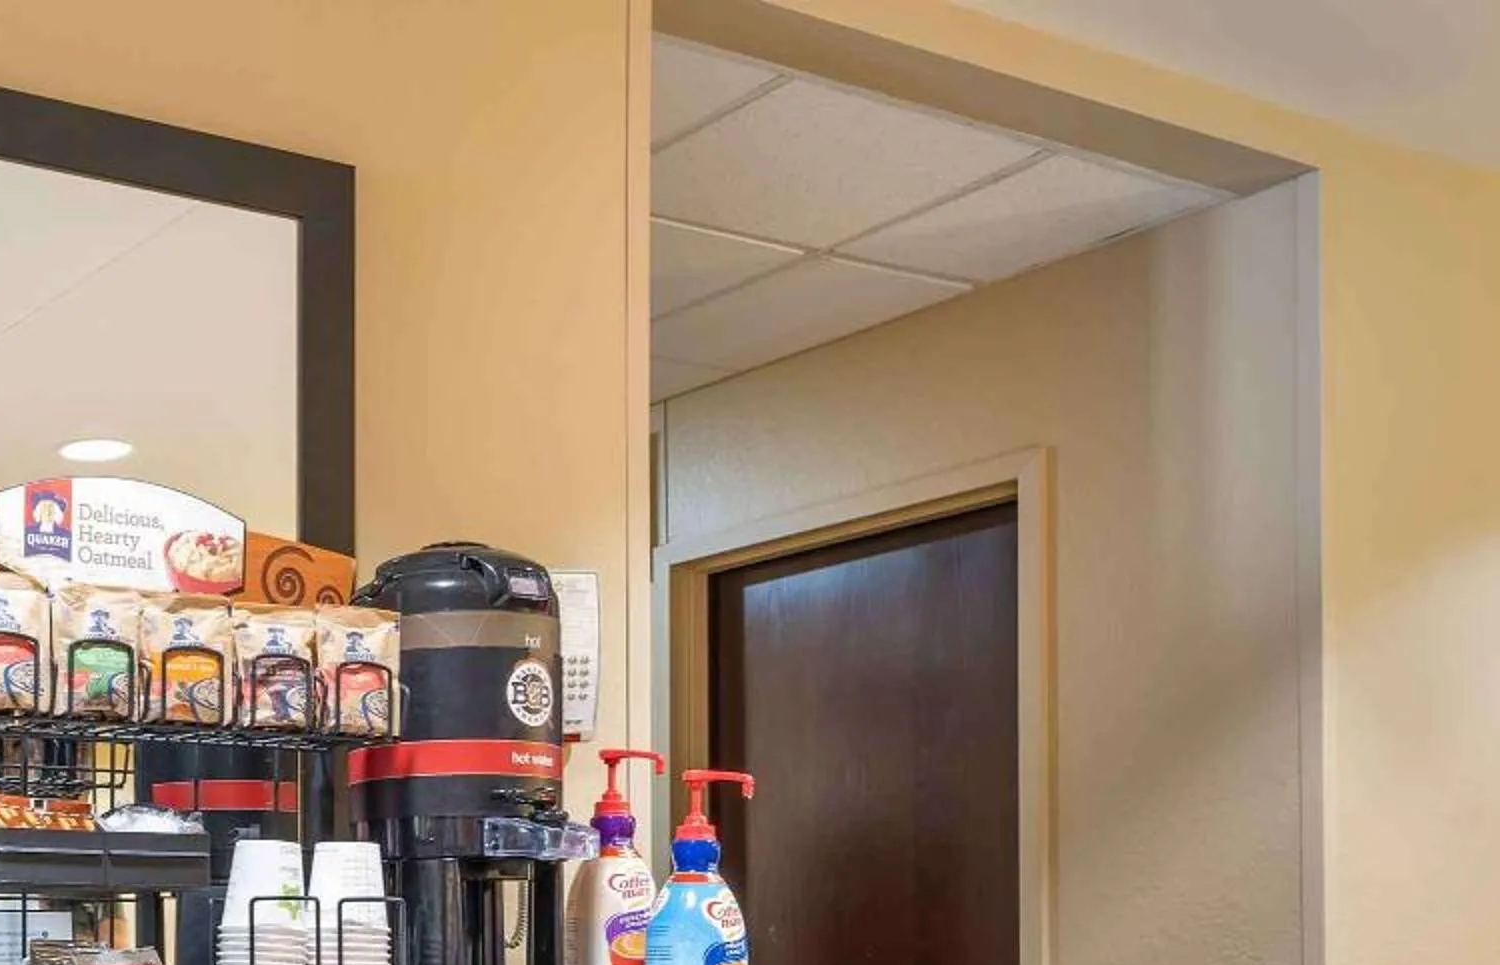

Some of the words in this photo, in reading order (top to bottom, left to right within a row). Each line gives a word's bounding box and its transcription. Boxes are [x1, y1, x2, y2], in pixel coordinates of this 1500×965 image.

[78, 502, 165, 532] Delicious,
[26, 533, 70, 550] QUAKER
[78, 524, 141, 550] Hearty
[77, 545, 153, 571] Oatmeal
[510, 751, 531, 766] hot
